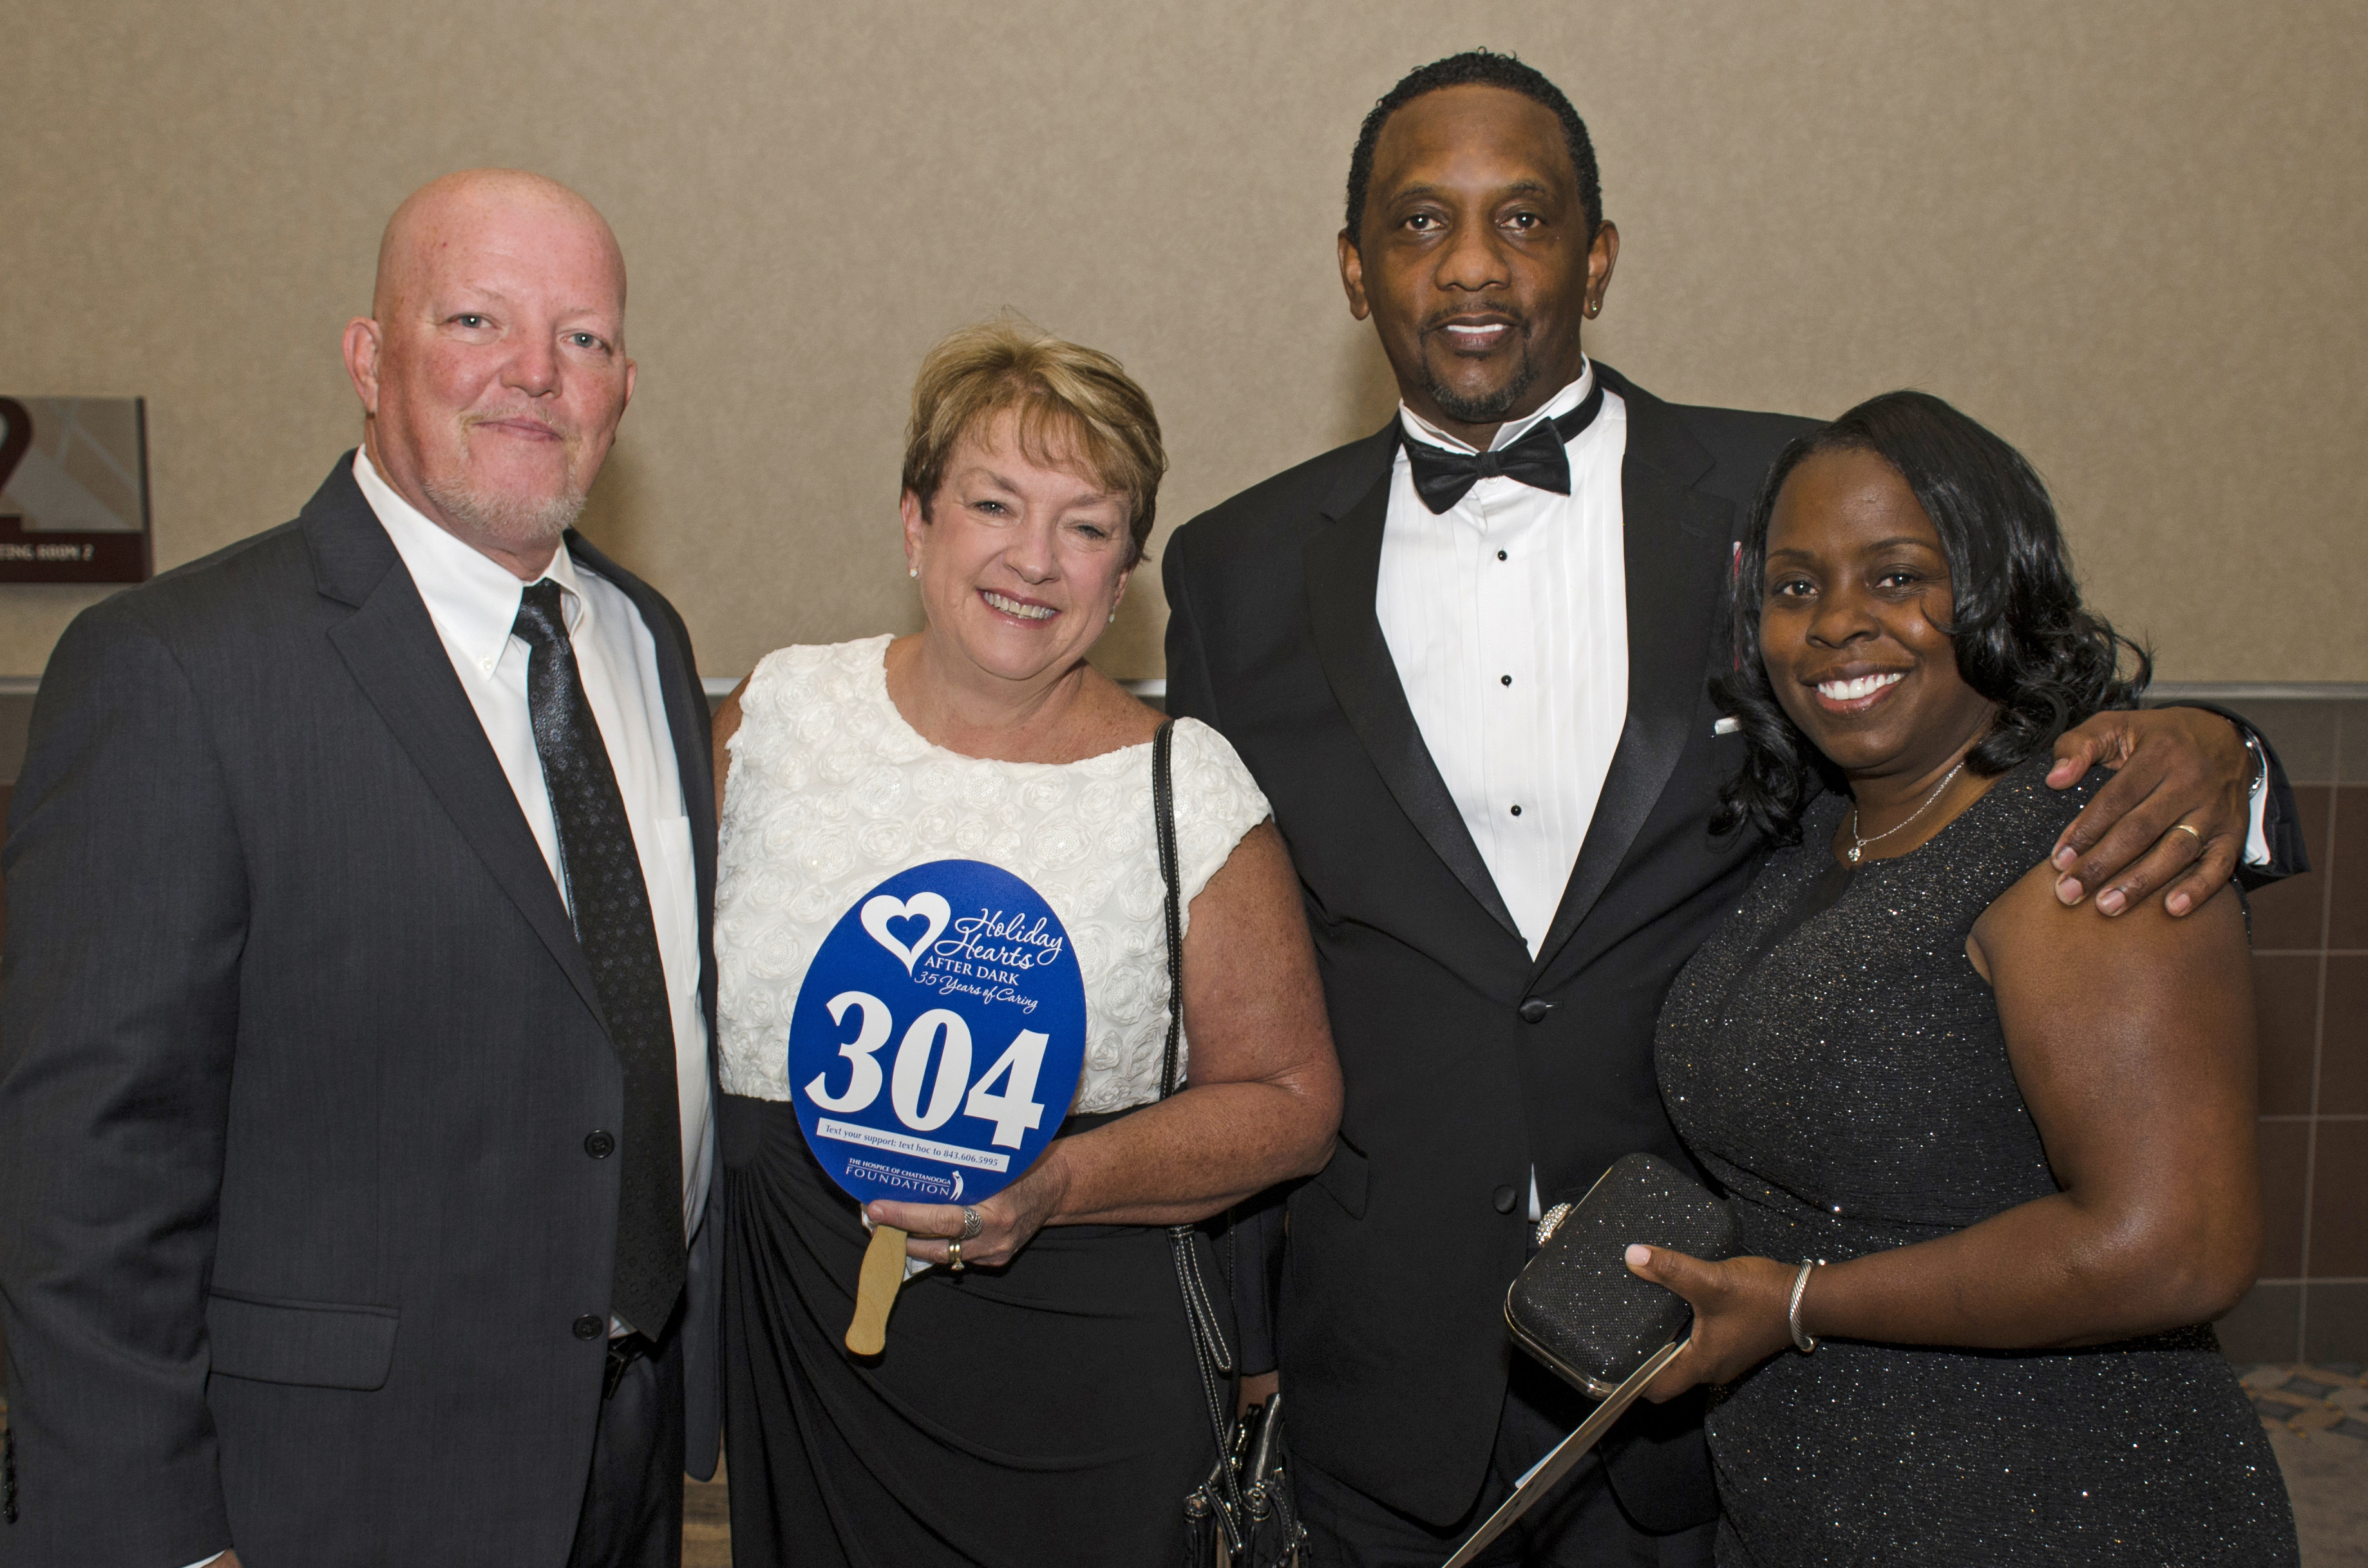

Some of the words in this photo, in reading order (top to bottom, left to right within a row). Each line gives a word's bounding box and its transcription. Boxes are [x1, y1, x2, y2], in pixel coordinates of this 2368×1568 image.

[934, 927, 1034, 969] Hearts
[955, 909, 1063, 965] Holiday
[924, 956, 972, 976] AFTER
[976, 966, 1019, 985] DARK
[914, 971, 940, 985] 35
[939, 976, 981, 995] Years
[983, 986, 998, 1005] of
[996, 988, 1038, 1014] Caring
[804, 991, 1050, 1150] 304
[826, 1125, 842, 1135] Text
[843, 1130, 862, 1139] your
[864, 1135, 896, 1147] support:
[898, 1141, 914, 1150] text
[916, 1144, 931, 1154] hoc
[933, 1148, 941, 1156] to
[943, 1150, 998, 1166] 843.606.5995
[846, 1166, 950, 1196] FOUNDATION
[862, 1160, 890, 1172] HOSPICE
[901, 1169, 951, 1185] CHATTANOOGA
